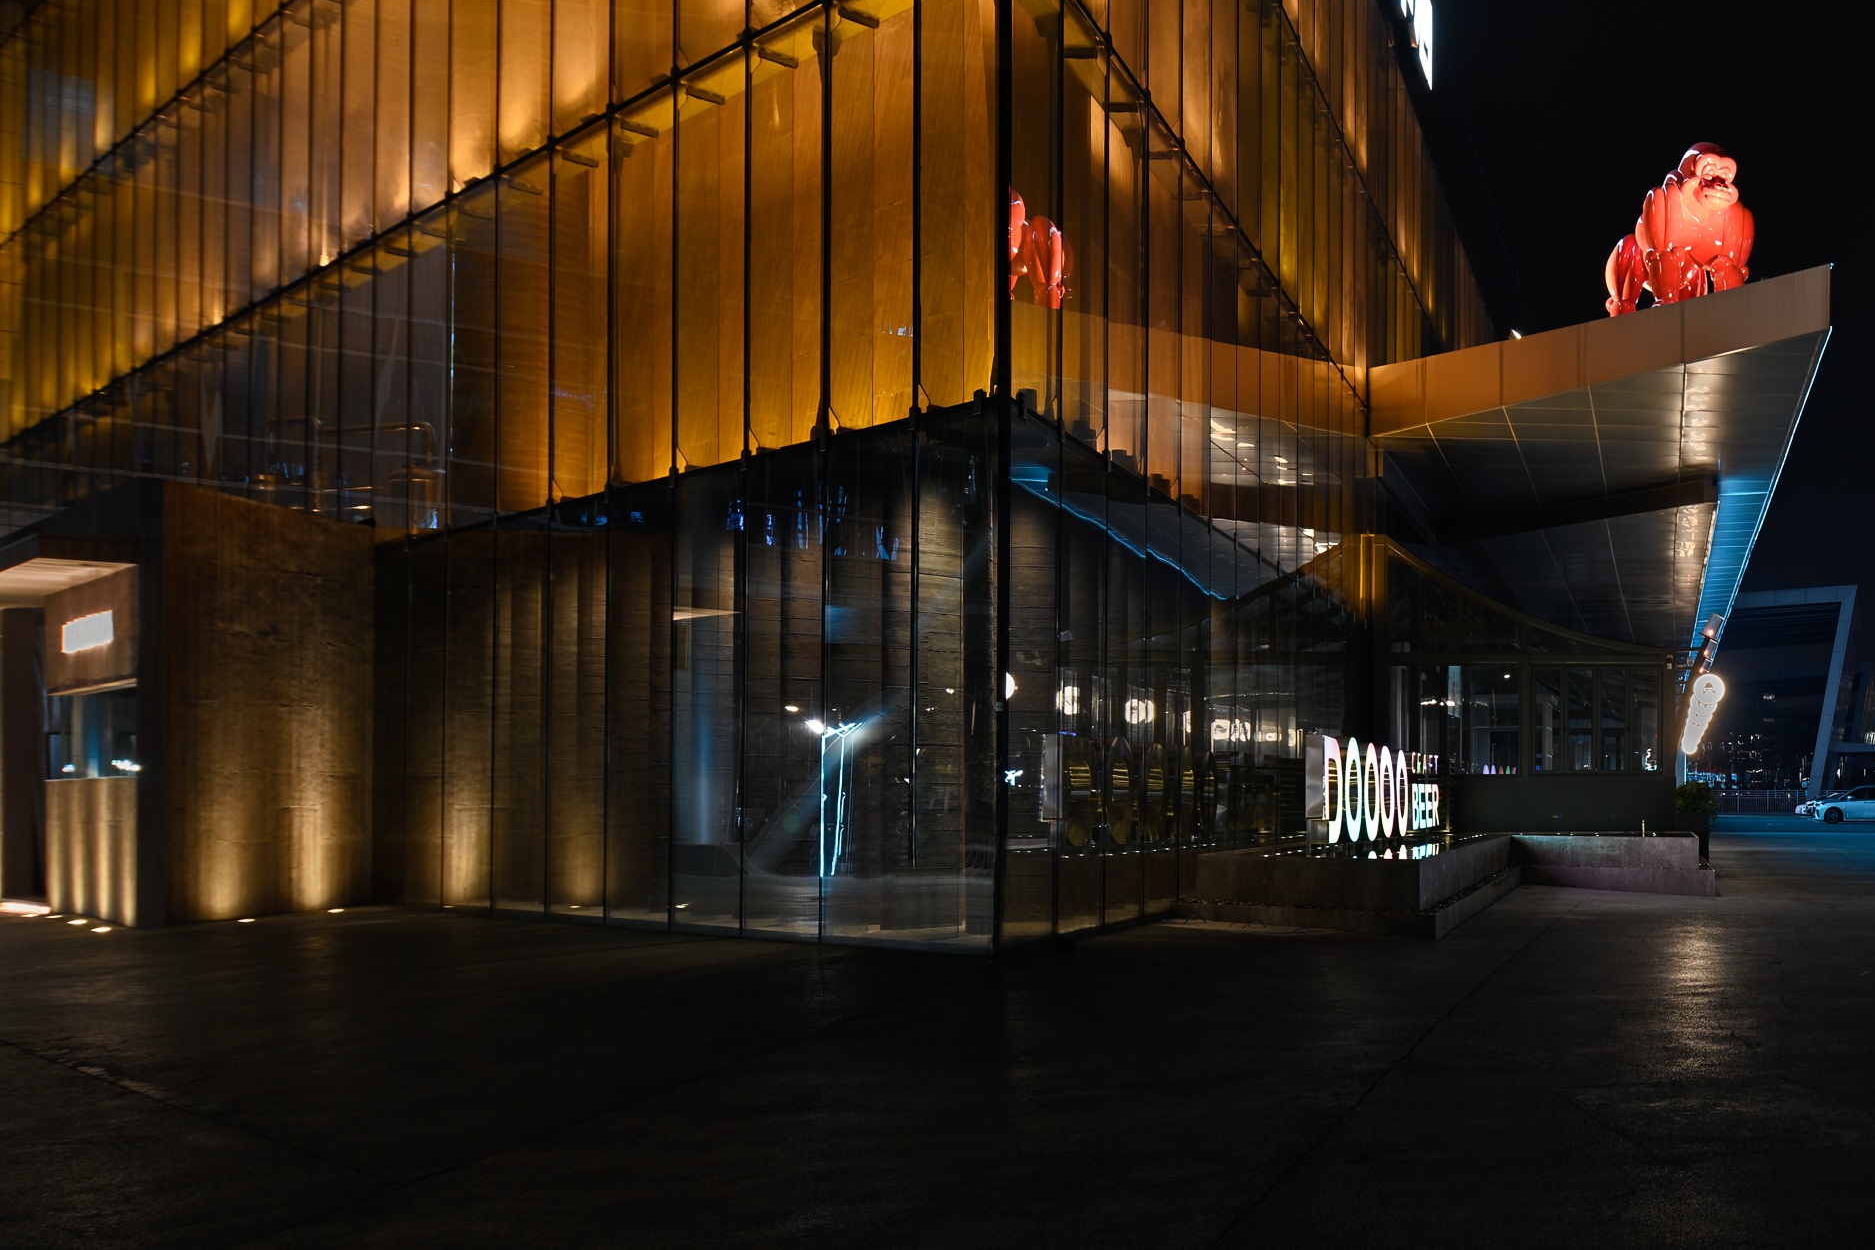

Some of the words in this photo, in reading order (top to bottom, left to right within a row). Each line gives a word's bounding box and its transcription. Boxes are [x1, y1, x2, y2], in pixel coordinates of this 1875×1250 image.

[1411, 751, 1440, 775] CRAFT
[1322, 735, 1409, 844] DOOOO
[1411, 783, 1440, 831] BEER
